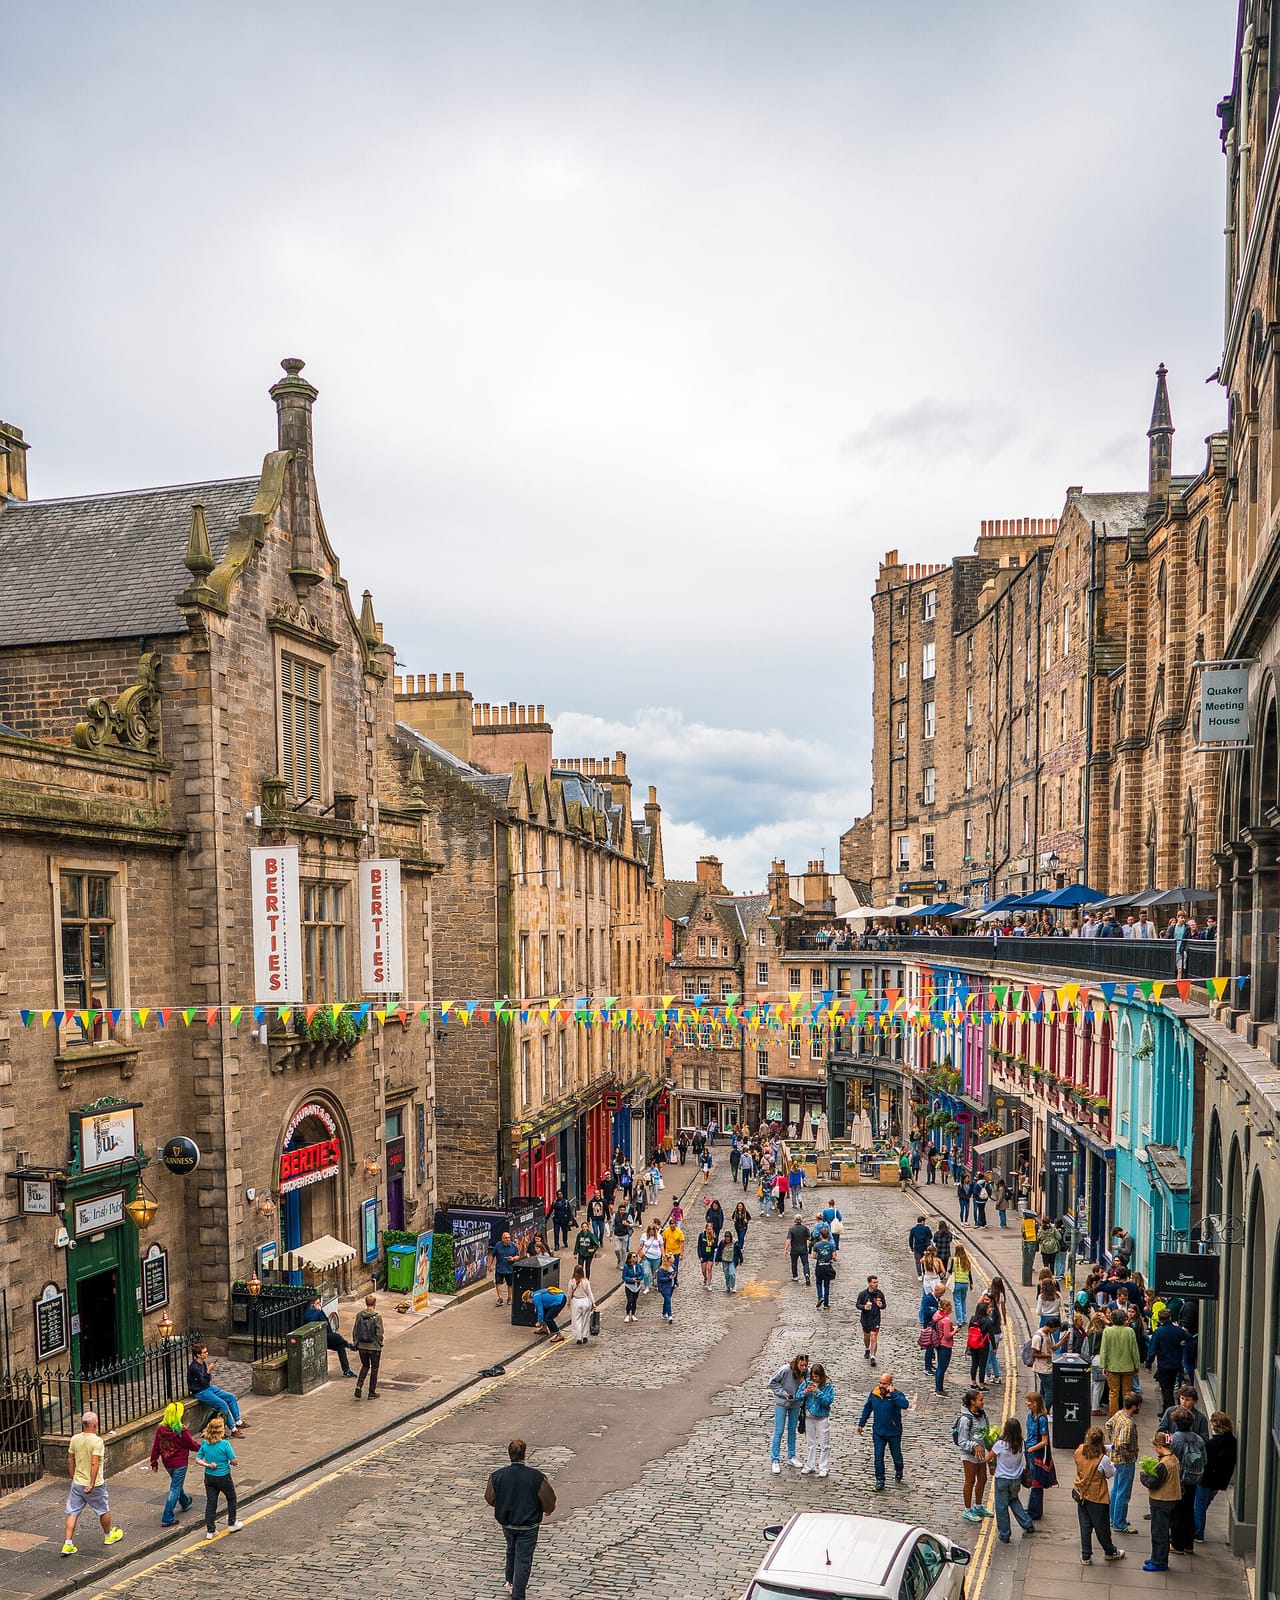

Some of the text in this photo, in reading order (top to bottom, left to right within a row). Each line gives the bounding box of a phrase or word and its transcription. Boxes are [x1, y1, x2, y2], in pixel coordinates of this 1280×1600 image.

[1206, 686, 1243, 696] Quaker
[1205, 701, 1244, 711] Meeting
[1208, 717, 1241, 726] House
[265, 858, 281, 991] BERTIES
[370, 869, 385, 983] BERTIES
[284, 1104, 320, 1148] RESTAURANT
[324, 1112, 337, 1134] BAR
[164, 1156, 194, 1165] GUINNESS
[280, 1138, 341, 1179] BERTIE'S
[281, 1176, 306, 1194] PROPER
[304, 1172, 318, 1186] FISH
[322, 1165, 340, 1179] CHIPS
[93, 1204, 108, 1220] Irish
[1165, 1279, 1208, 1288] Walker Slater
